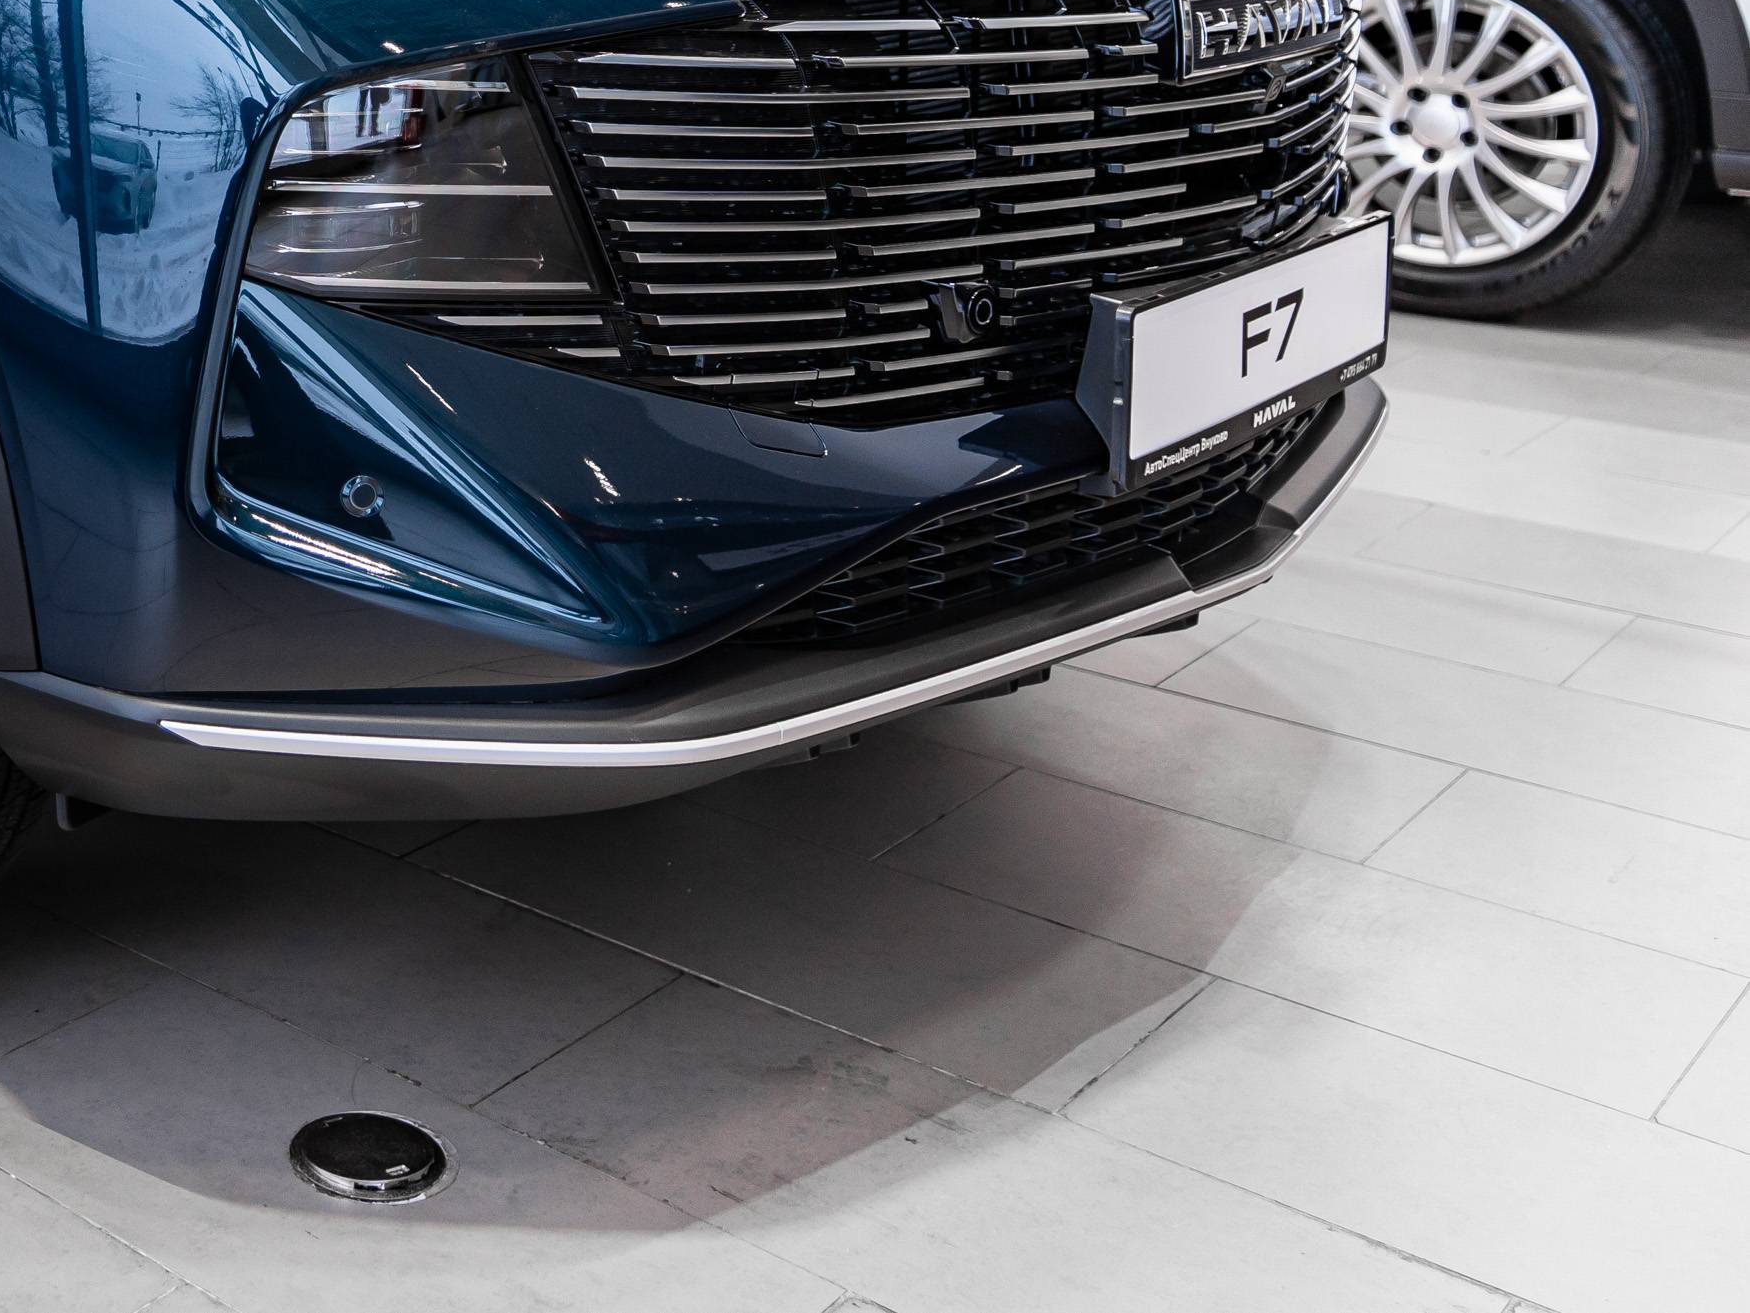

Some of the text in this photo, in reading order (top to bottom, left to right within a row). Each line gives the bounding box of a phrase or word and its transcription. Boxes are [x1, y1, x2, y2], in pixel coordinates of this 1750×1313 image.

[1242, 288, 1304, 378] F7
[1253, 395, 1297, 428] HAVAL
[1144, 430, 1229, 476] АвтоСпецЦентр Внуково
